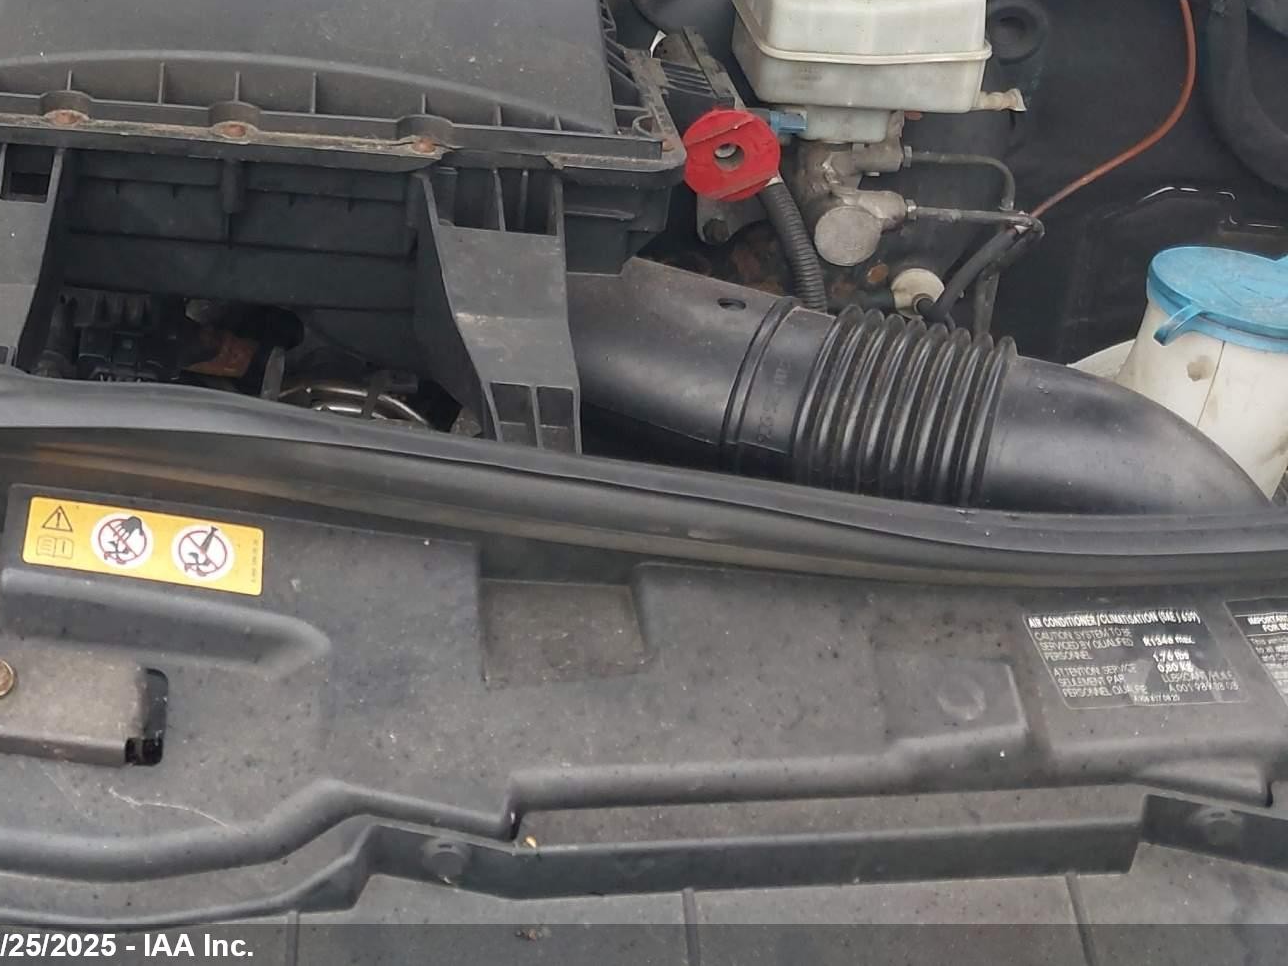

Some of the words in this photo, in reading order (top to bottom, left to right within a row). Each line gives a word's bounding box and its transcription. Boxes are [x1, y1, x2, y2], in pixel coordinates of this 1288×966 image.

[1028, 617, 1042, 628] AIR
[1039, 641, 1079, 651] SERVICED
[1079, 640, 1092, 650] BY
[1092, 637, 1134, 649] QUALIFIED
[1142, 634, 1174, 646] R134a
[1044, 651, 1093, 661] PERSONNEL
[1057, 677, 1105, 687] SEULEMENT
[1106, 674, 1125, 685] PAR
[1062, 687, 1112, 698] PERSONNEL
